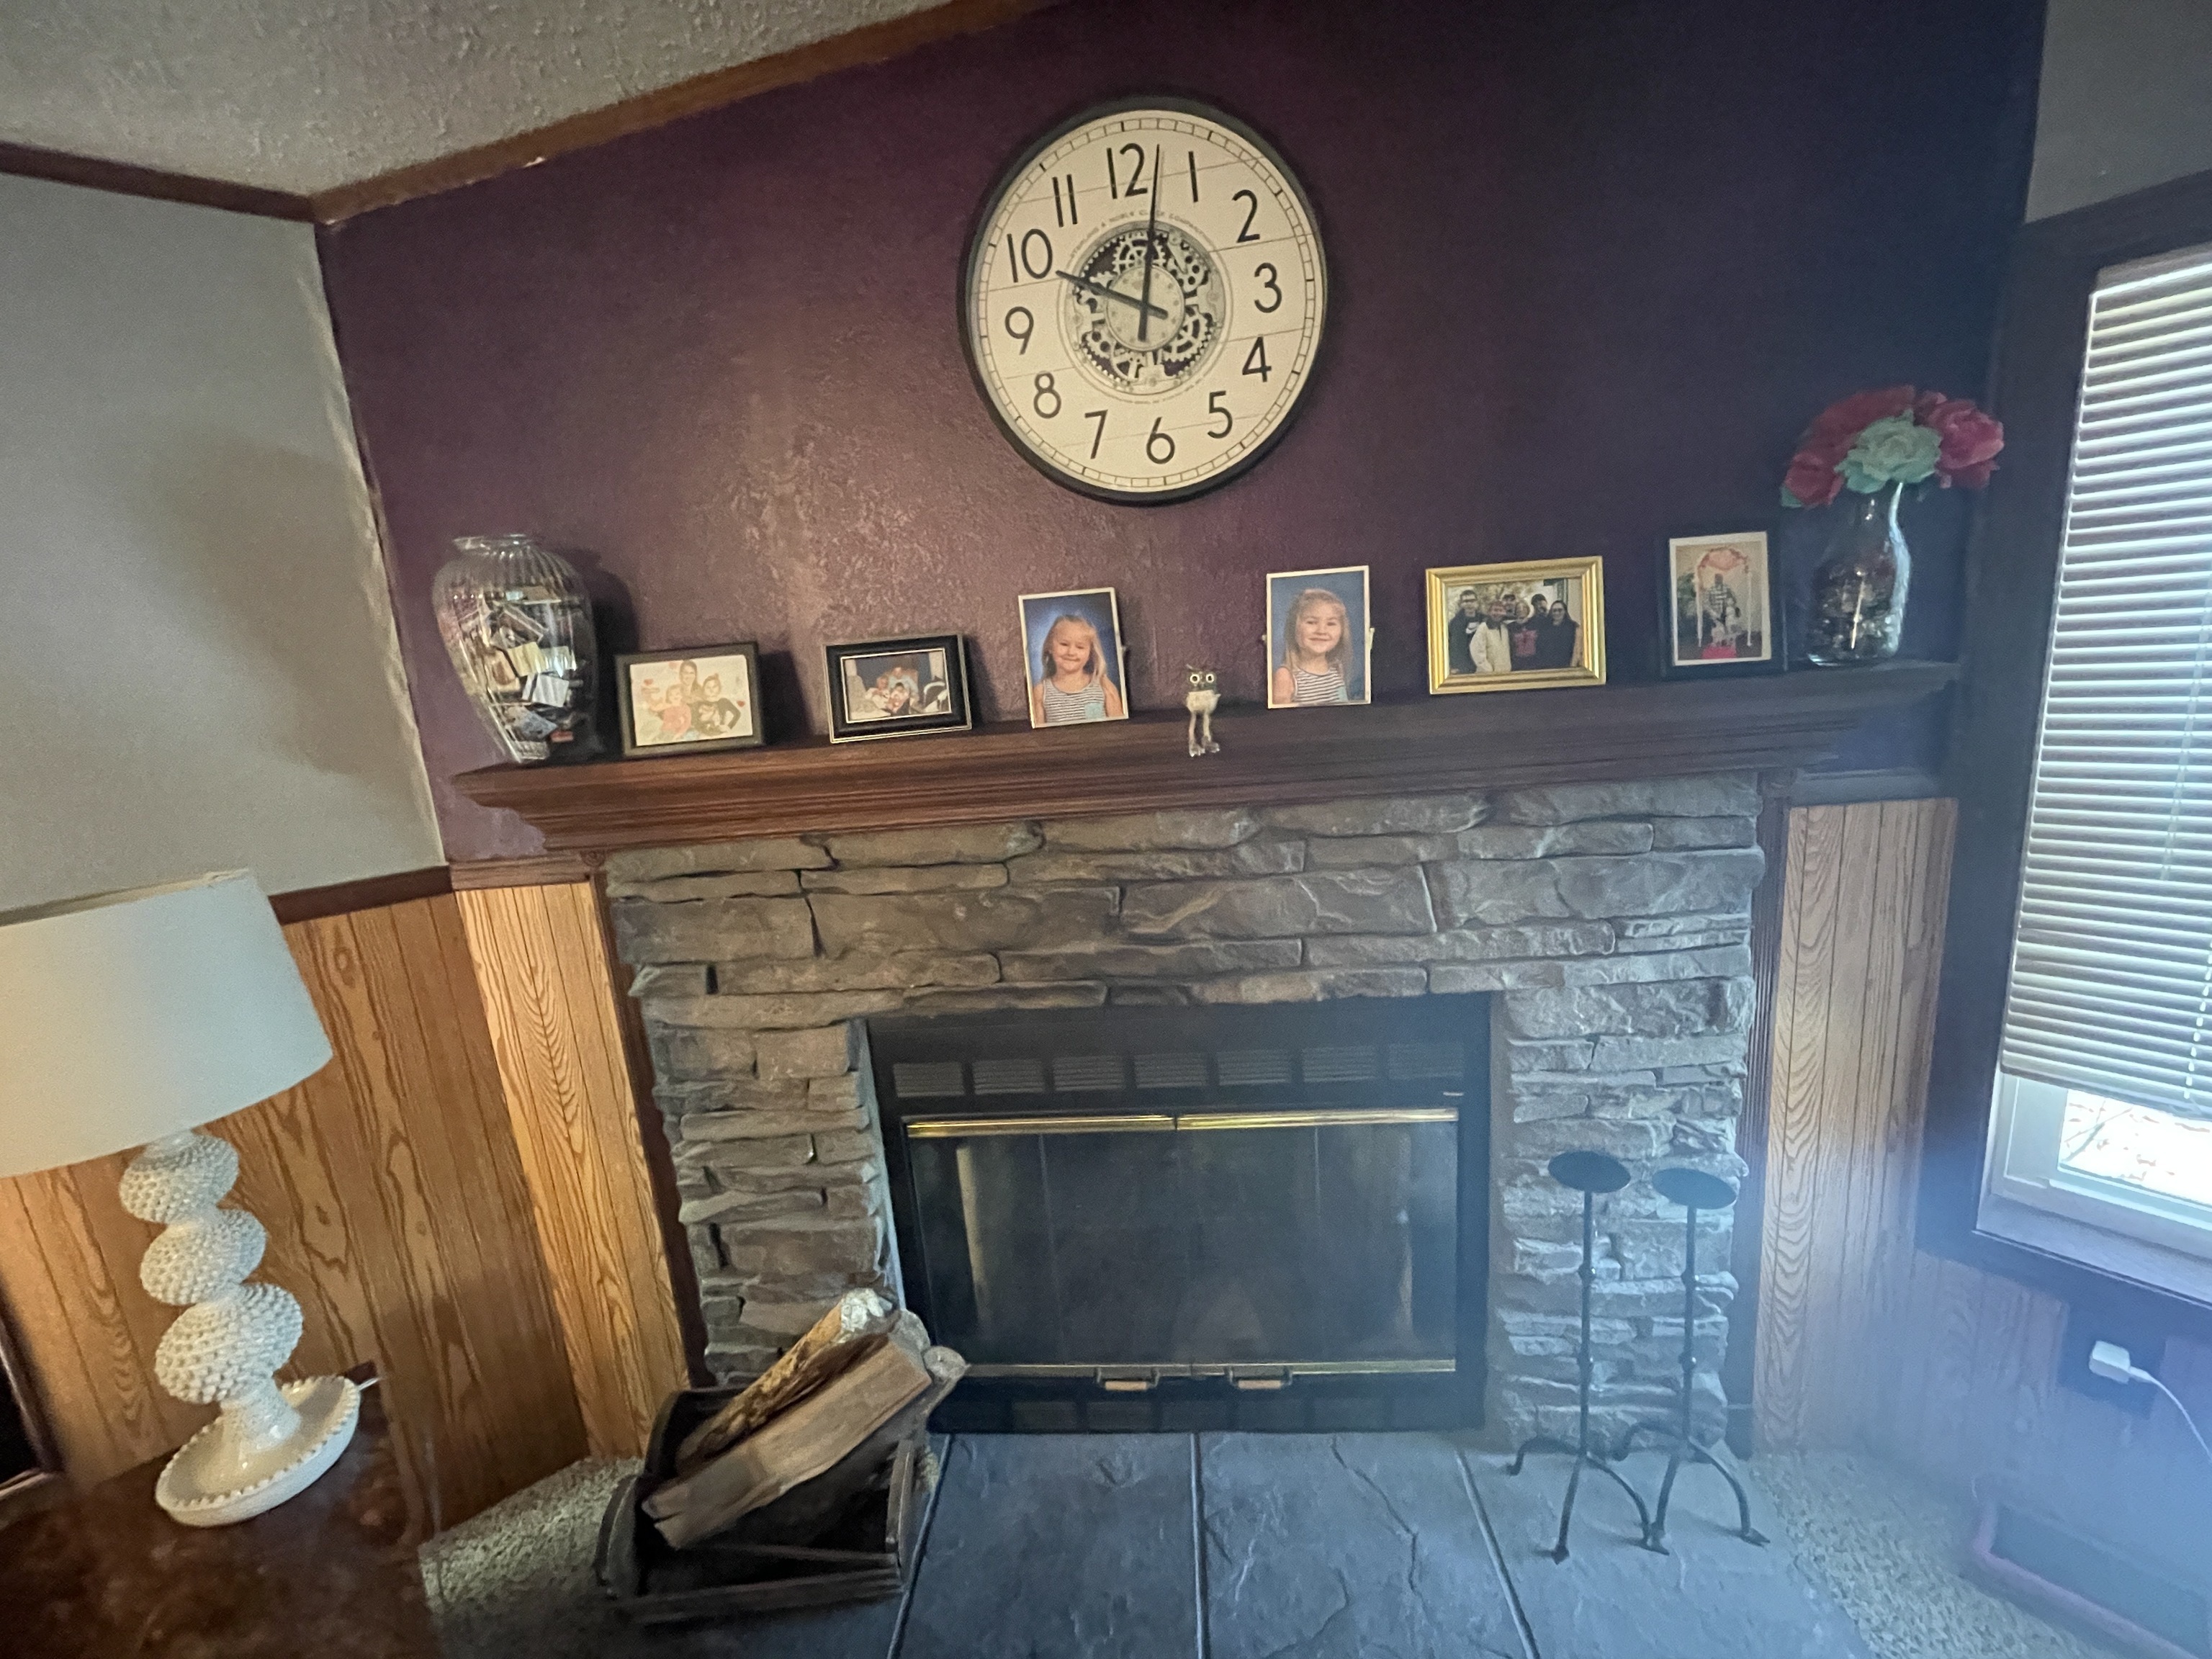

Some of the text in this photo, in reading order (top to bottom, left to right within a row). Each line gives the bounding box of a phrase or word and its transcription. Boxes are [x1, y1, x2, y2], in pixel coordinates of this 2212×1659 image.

[1107, 143, 1148, 199] 12
[1188, 151, 1199, 203] 1
[1052, 174, 1077, 228] 11
[1232, 189, 1260, 243] 2
[1007, 229, 1053, 283] 10
[1254, 263, 1282, 313] 3
[1005, 307, 1034, 354] 9
[1242, 336, 1272, 382] 4
[1034, 372, 1061, 418] 8
[1208, 390, 1233, 439] 5
[1085, 409, 1108, 459] 7
[1146, 417, 1175, 464] 6
